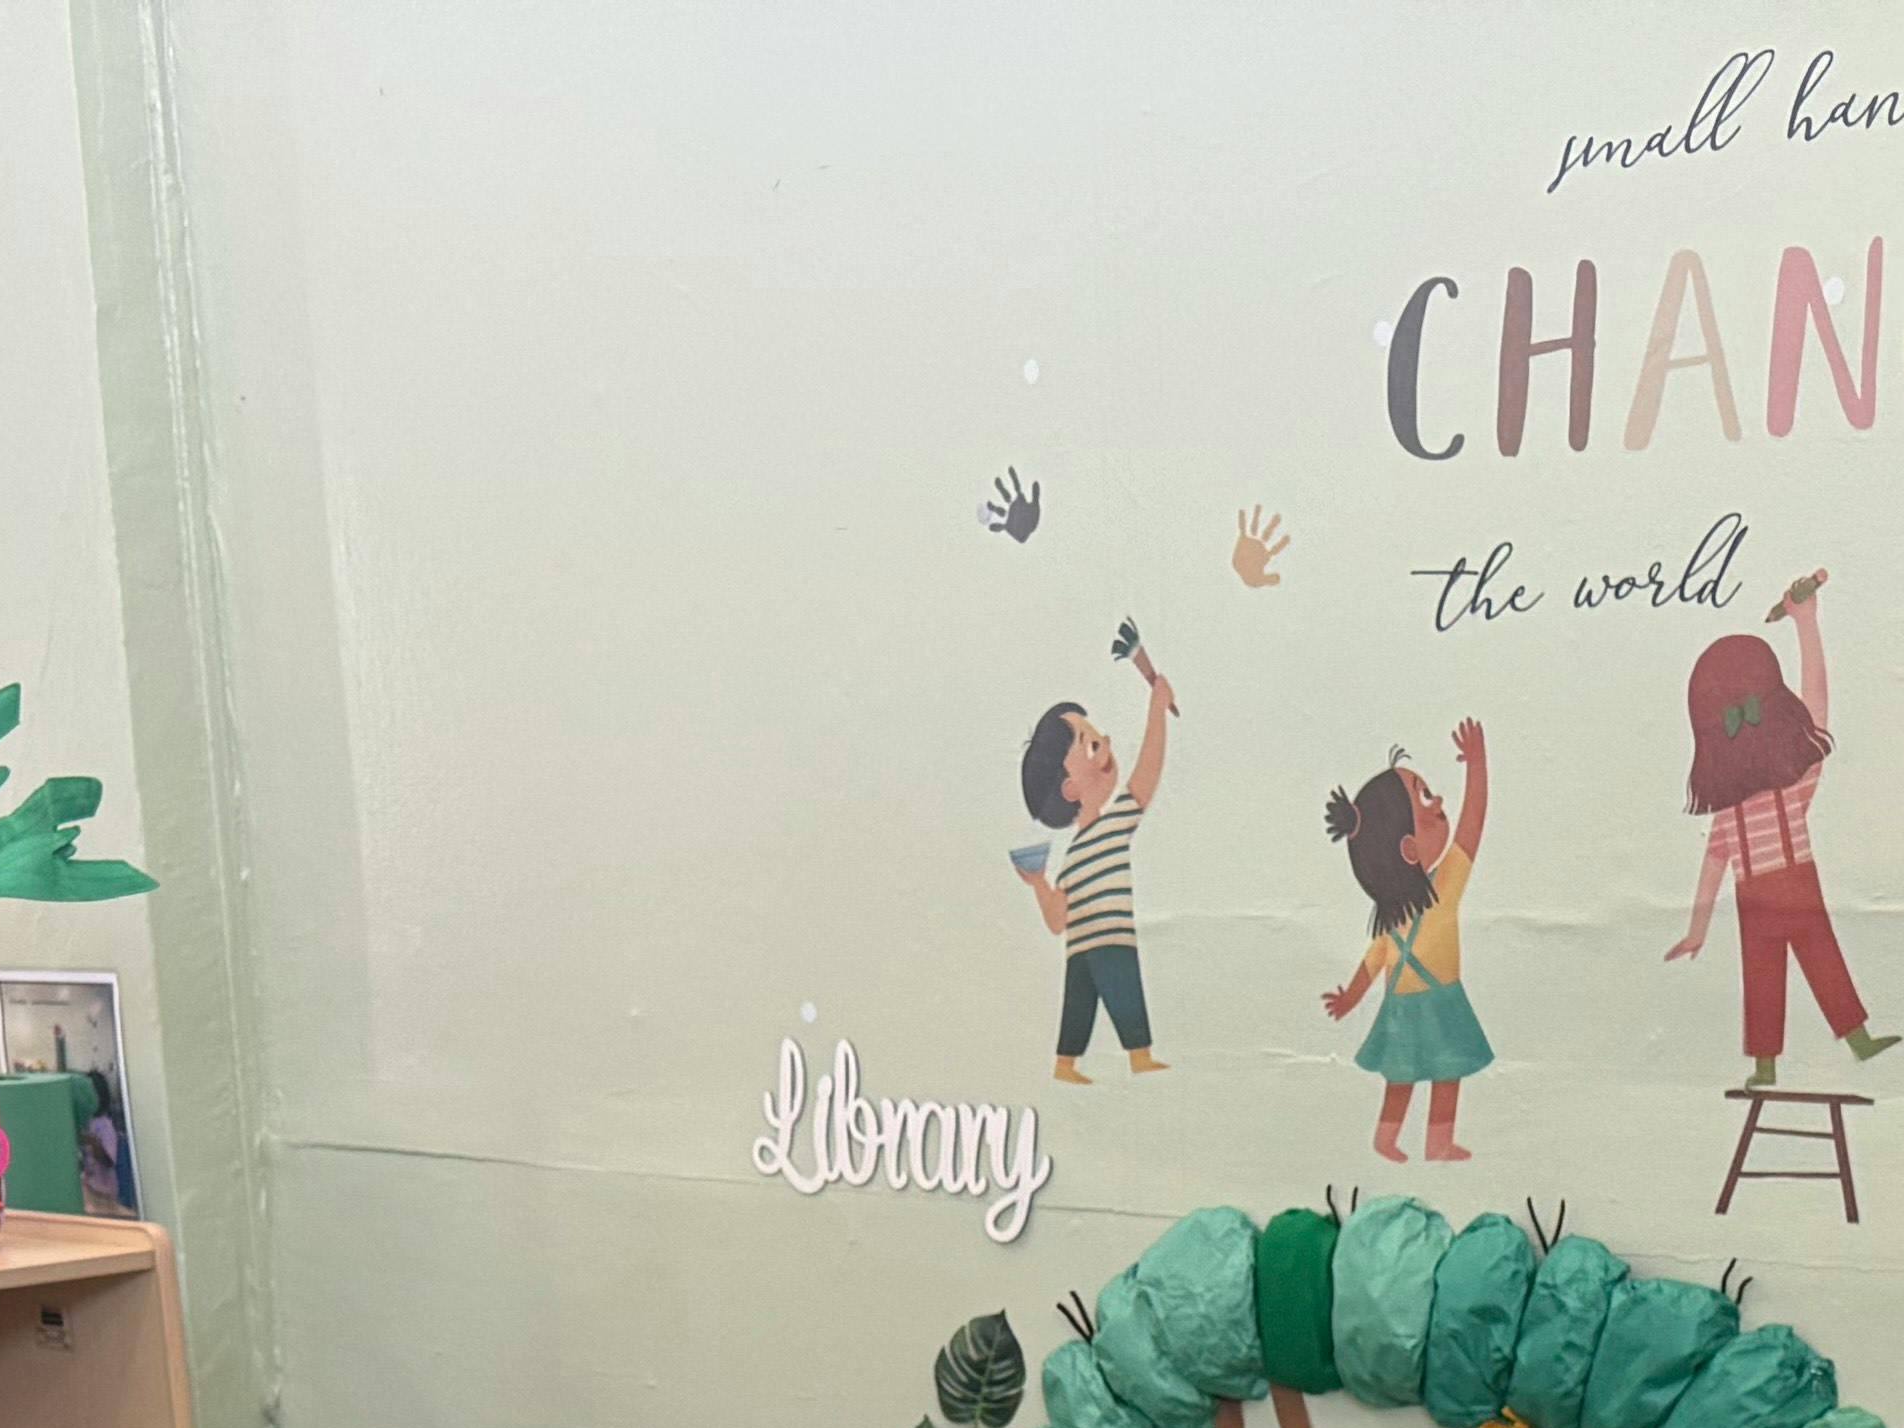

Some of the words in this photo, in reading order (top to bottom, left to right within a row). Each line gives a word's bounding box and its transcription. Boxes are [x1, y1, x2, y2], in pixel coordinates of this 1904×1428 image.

[1547, 49, 1775, 193] small
[1411, 541, 1545, 633] the
[1574, 512, 1749, 608] world
[752, 1037, 1052, 1243] Library
